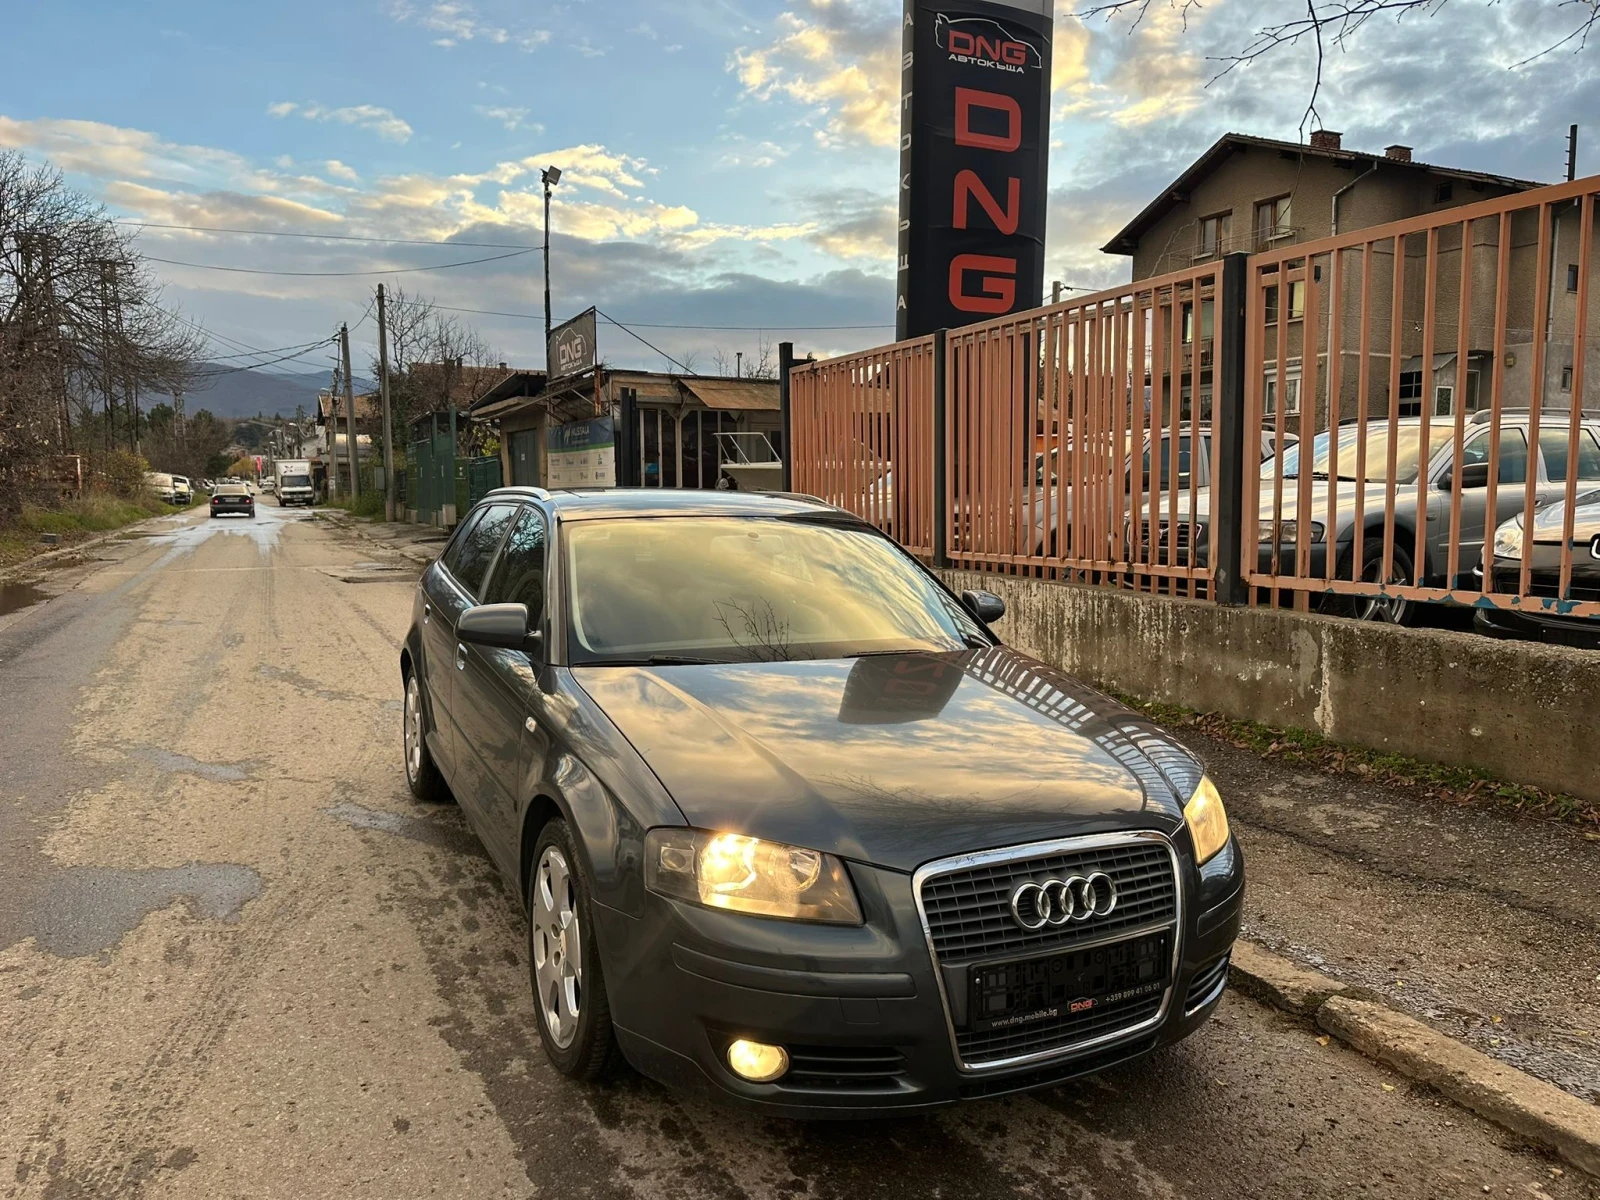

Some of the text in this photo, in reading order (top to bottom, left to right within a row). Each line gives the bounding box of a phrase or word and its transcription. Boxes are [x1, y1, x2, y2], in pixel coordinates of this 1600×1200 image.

[948, 29, 1027, 65] DNG
[948, 53, 1025, 74] АВТОКЪША
[948, 87, 1022, 314] DNG
[559, 337, 582, 365] DNG
[1070, 999, 1093, 1011] DNG
[1105, 993, 1122, 1003] +359
[1123, 990, 1135, 999] 899
[1136, 988, 1143, 996] 41
[991, 1008, 1058, 1028] www.dng.mobile.bg
